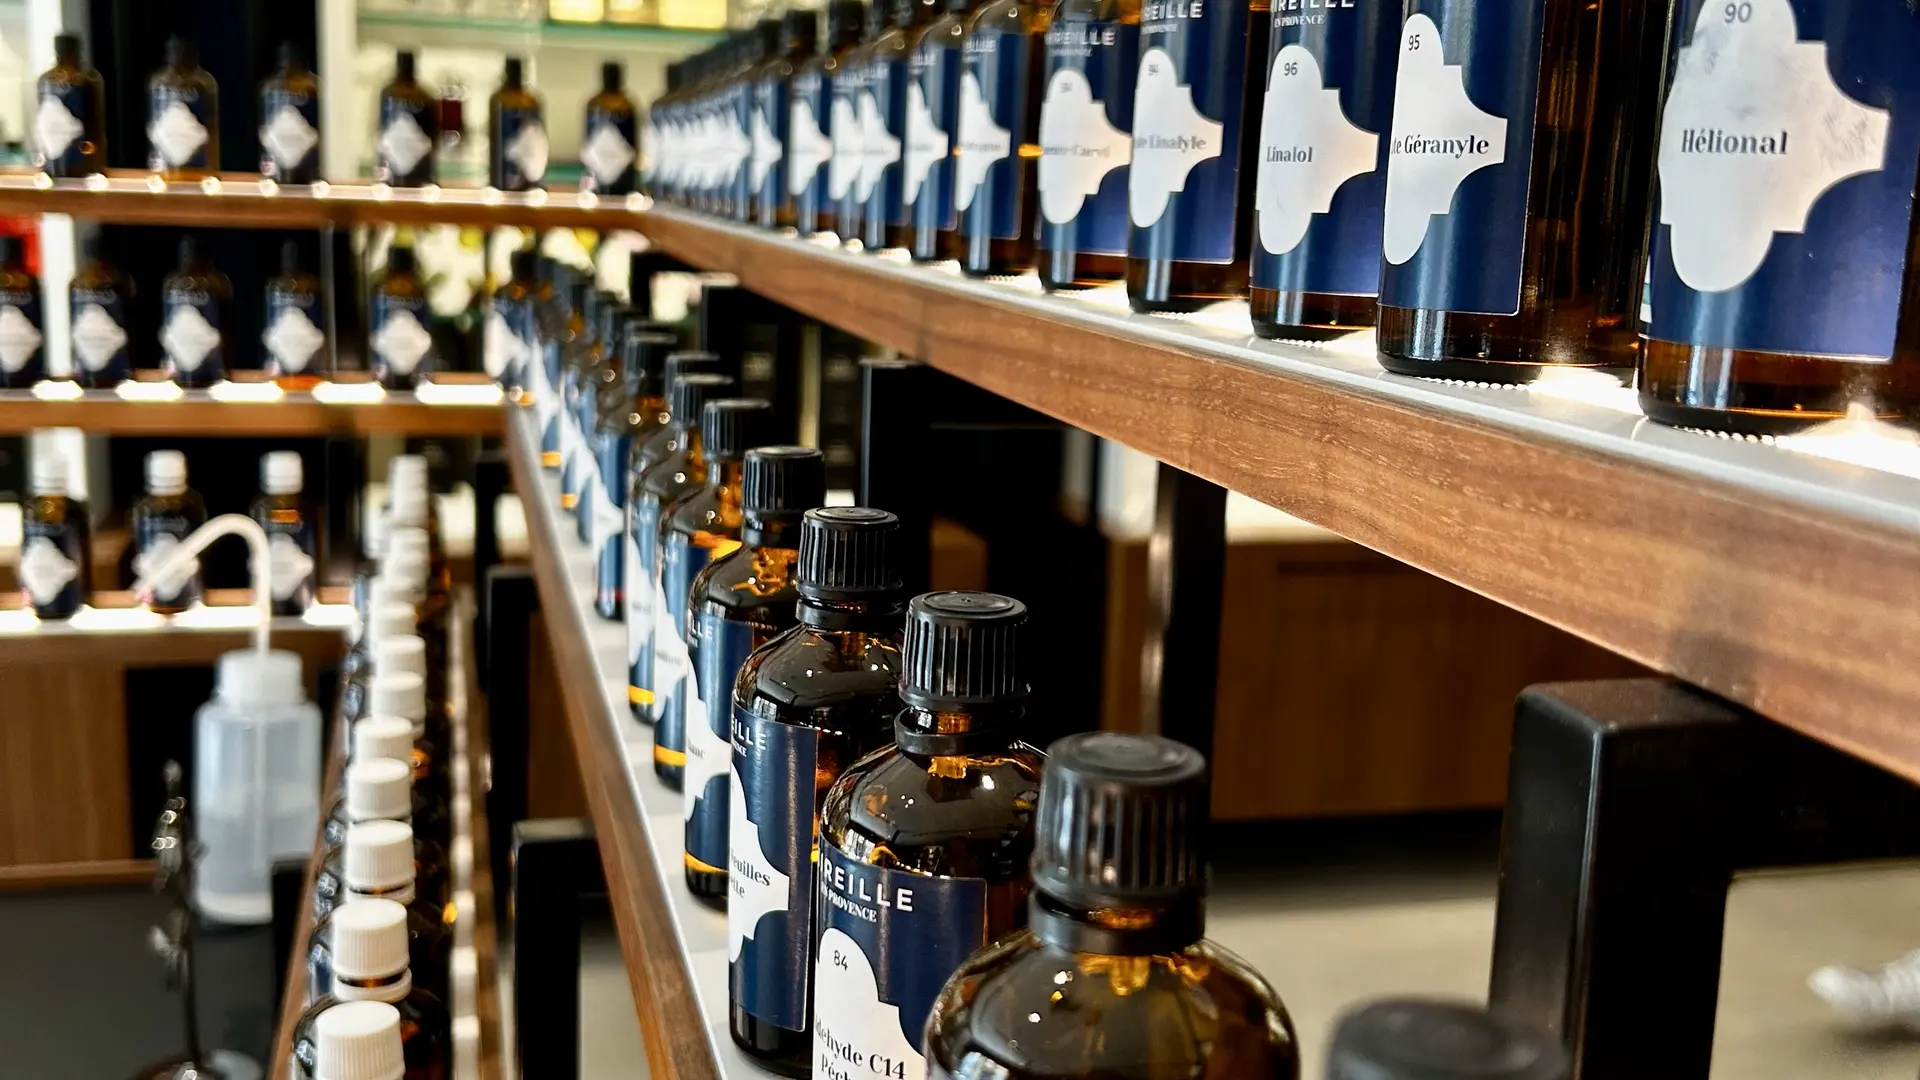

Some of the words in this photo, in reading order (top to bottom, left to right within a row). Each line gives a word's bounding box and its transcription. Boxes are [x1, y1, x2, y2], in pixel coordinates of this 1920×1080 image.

[1724, 3, 1752, 23] 90
[1408, 34, 1420, 51] 95
[1283, 62, 1298, 76] 96
[1404, 133, 1490, 159] Géranyle
[1681, 128, 1788, 155] Hélional
[1266, 146, 1313, 163] Linalol
[828, 888, 877, 923] PROVENCE
[833, 949, 848, 971] 84
[869, 1053, 906, 1080] C14
